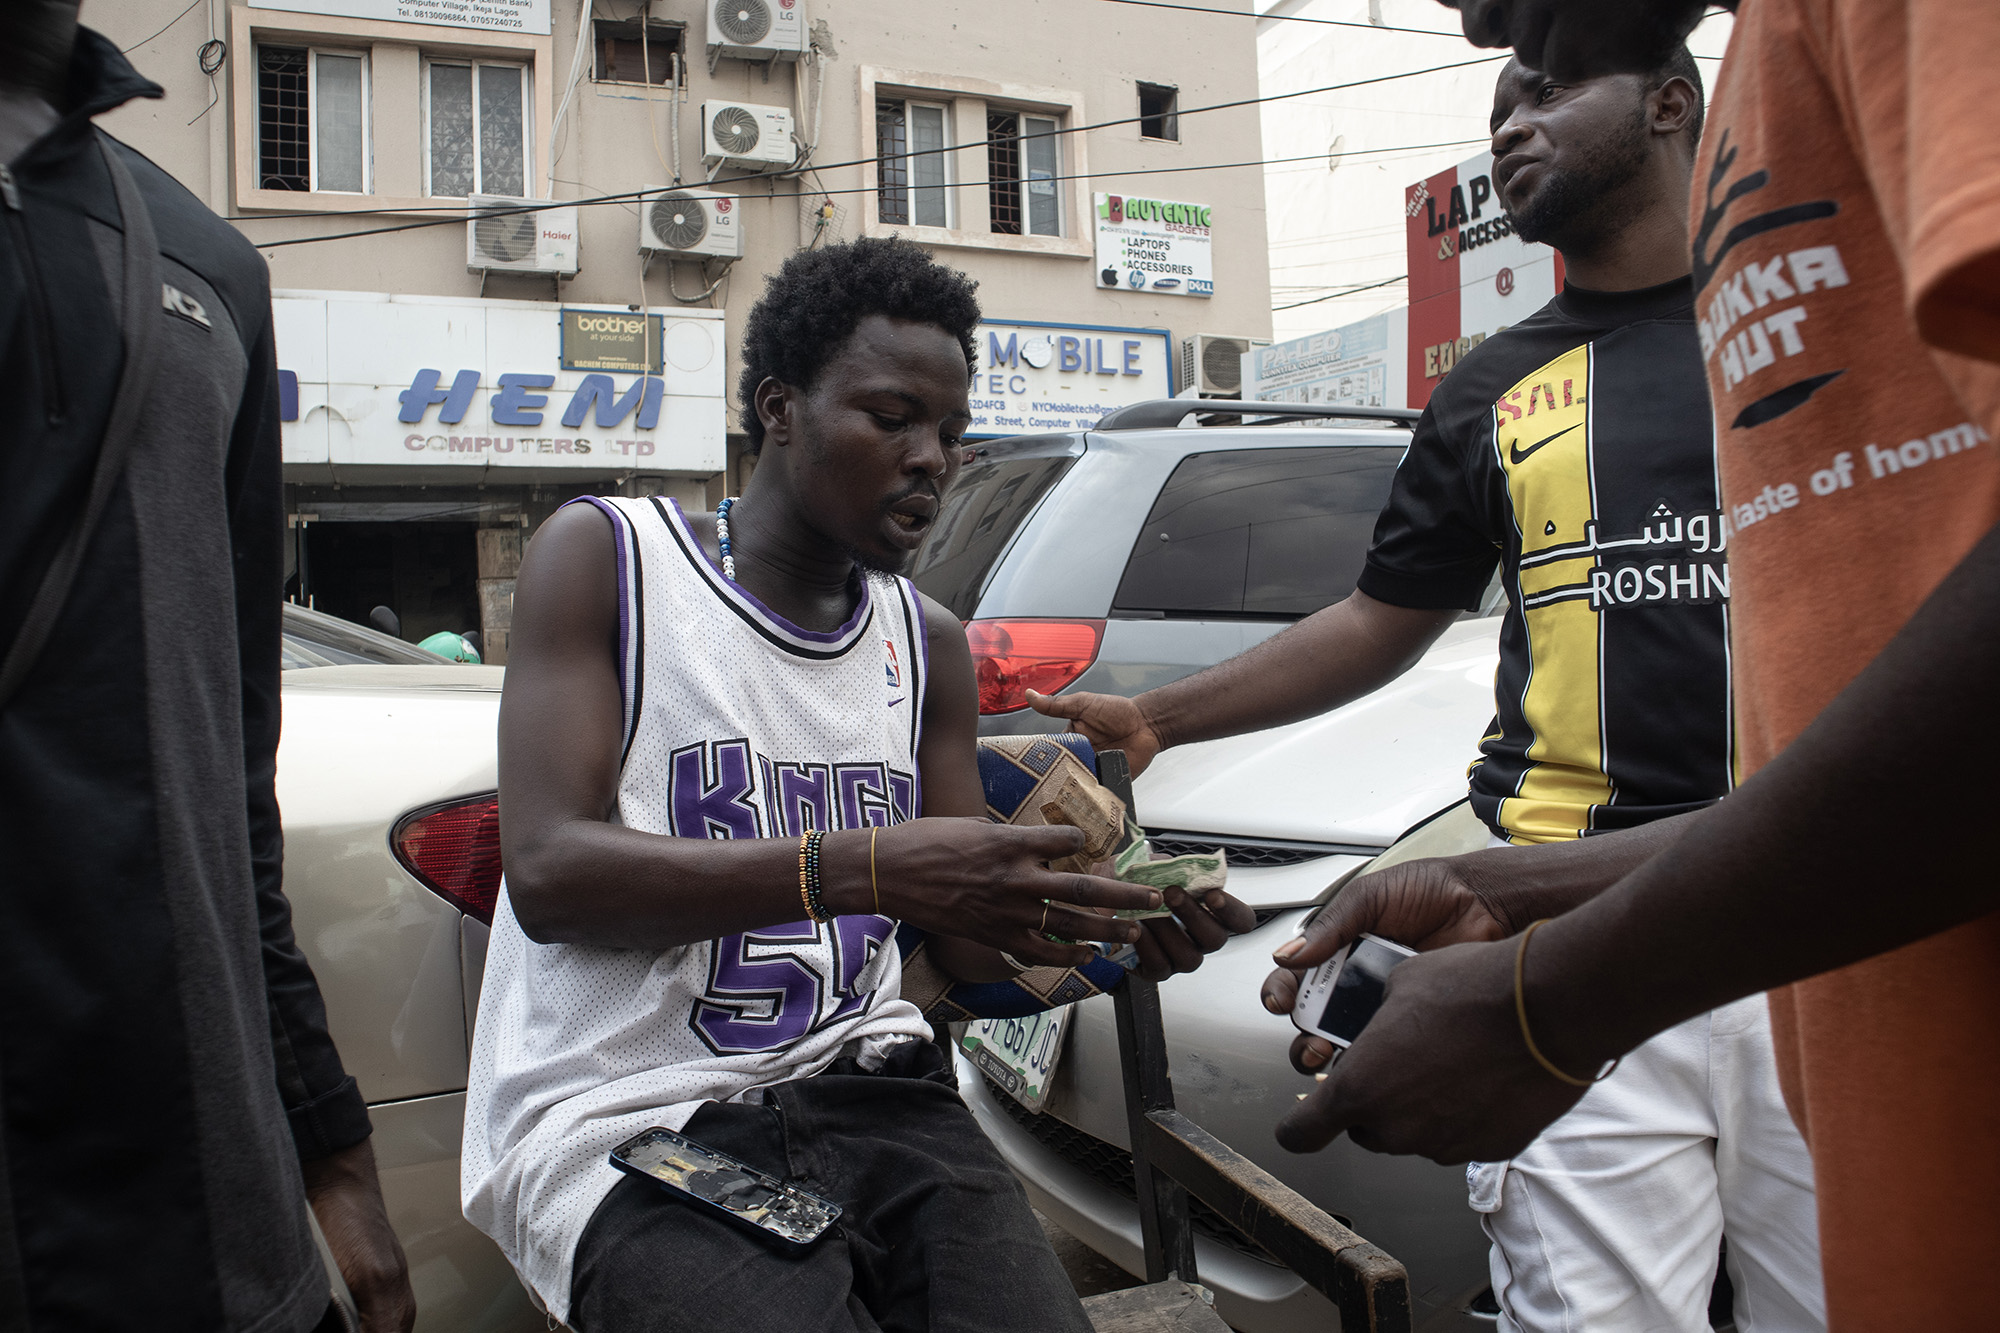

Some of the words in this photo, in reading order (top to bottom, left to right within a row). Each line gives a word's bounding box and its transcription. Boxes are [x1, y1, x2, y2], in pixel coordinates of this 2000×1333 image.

[397, 8, 412, 17] Tel.
[442, 1, 471, 12] Village,
[473, 4, 492, 14] Ikeja
[494, 7, 519, 17] Lagos
[780, 12, 794, 20] LG
[1126, 198, 1212, 227] AUTENTIC
[1426, 174, 1492, 238] LAP
[716, 216, 730, 225] LG
[543, 231, 571, 240] Haier
[1165, 223, 1210, 236] GADGETS
[1438, 235, 1455, 261] &
[1458, 213, 1511, 254] ACCESS
[1127, 237, 1171, 251] LAPTOPS
[1127, 248, 1167, 262] PHONES
[1127, 260, 1194, 276] ACCESSORIES
[1188, 280, 1213, 292] DELL
[1496, 267, 1514, 296] @
[577, 314, 646, 334] brother
[590, 333, 598, 341] at
[600, 333, 617, 342] your
[619, 334, 635, 342] side
[1720, 305, 1808, 393] HUT
[994, 416, 1025, 428] Street,
[1028, 418, 1071, 428] Computer
[1075, 419, 1097, 429] Villa
[1732, 482, 1800, 531] taste
[1810, 451, 1854, 497] of
[987, 1059, 1008, 1083] TOYOTA
